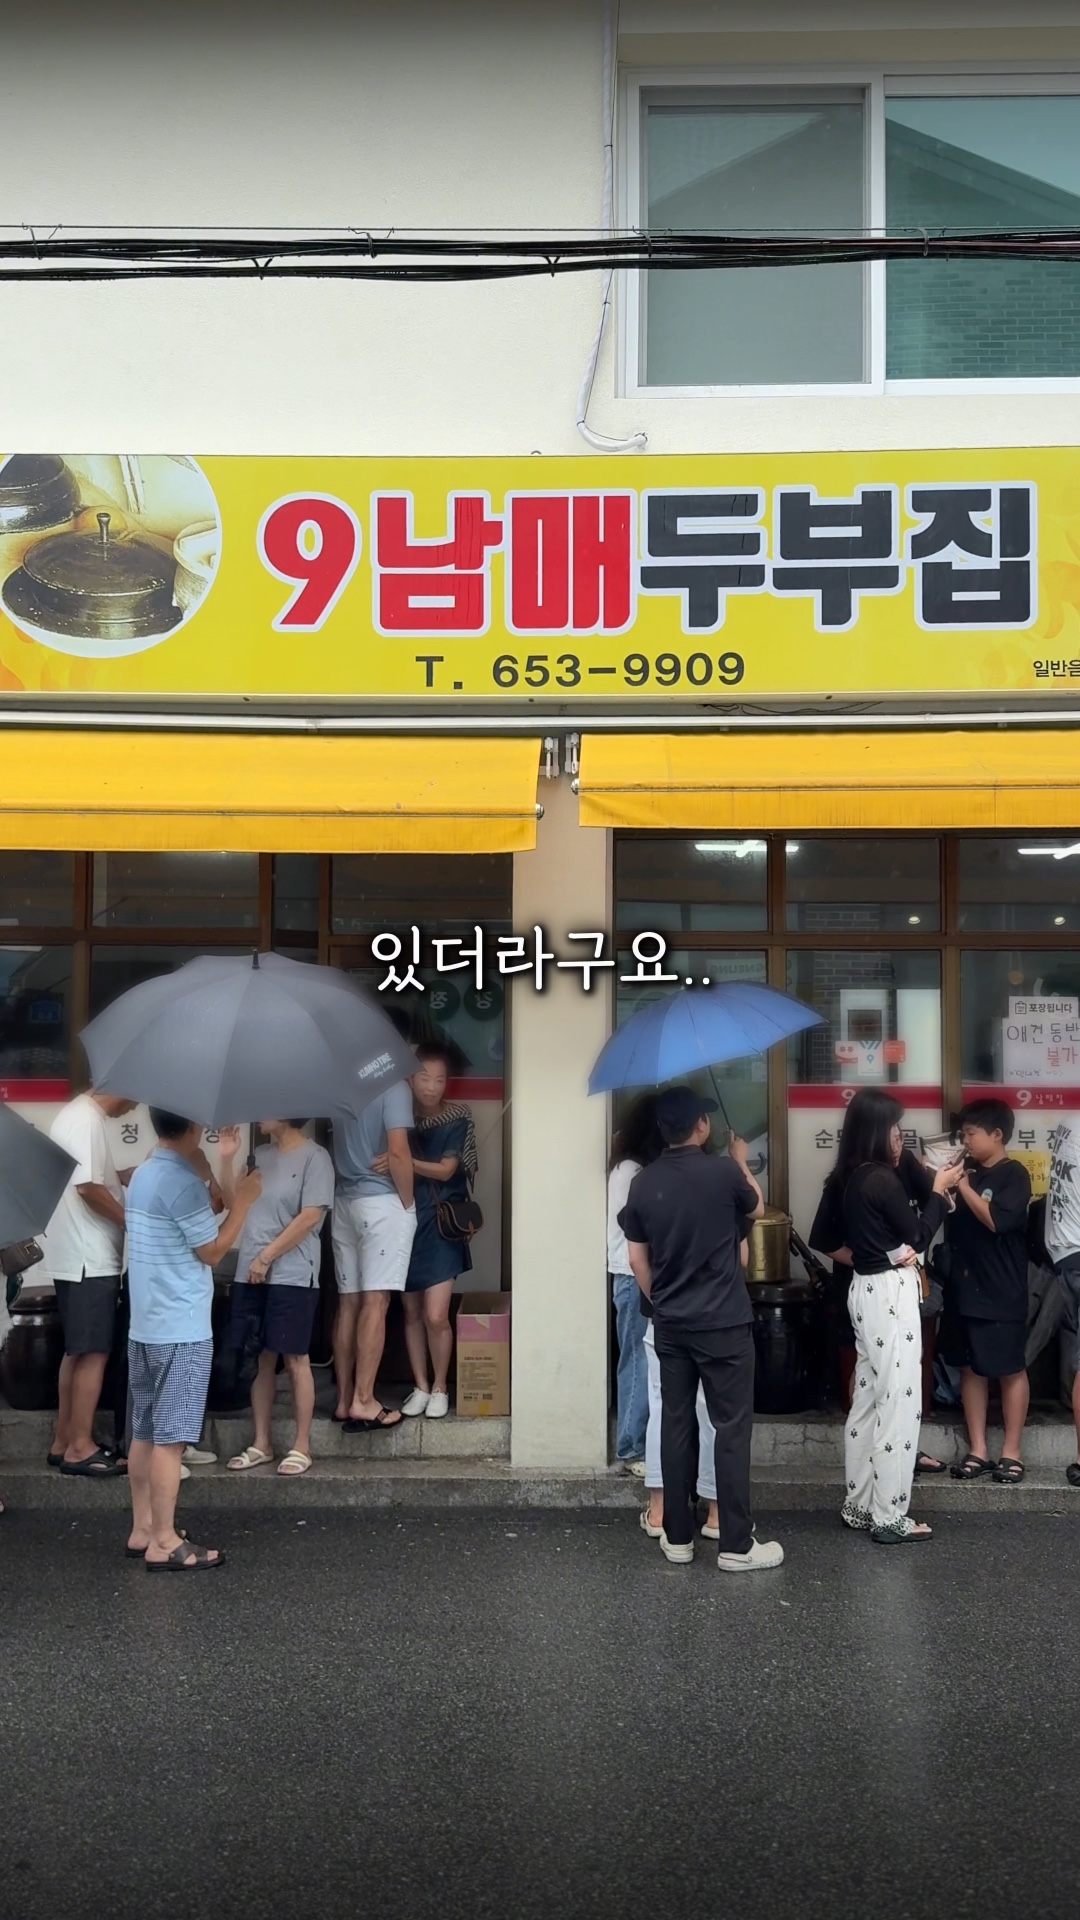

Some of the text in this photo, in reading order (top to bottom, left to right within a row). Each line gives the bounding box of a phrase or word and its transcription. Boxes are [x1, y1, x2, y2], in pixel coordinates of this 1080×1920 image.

[258, 484, 1038, 637] 9남매두부집
[415, 651, 745, 690] T. 653-9909
[1028, 1003, 1073, 1014] 포장됩니다
[357, 1059, 380, 1080] KUMHO
[376, 1052, 392, 1066] TIRE
[1047, 1046, 1078, 1067] 불가
